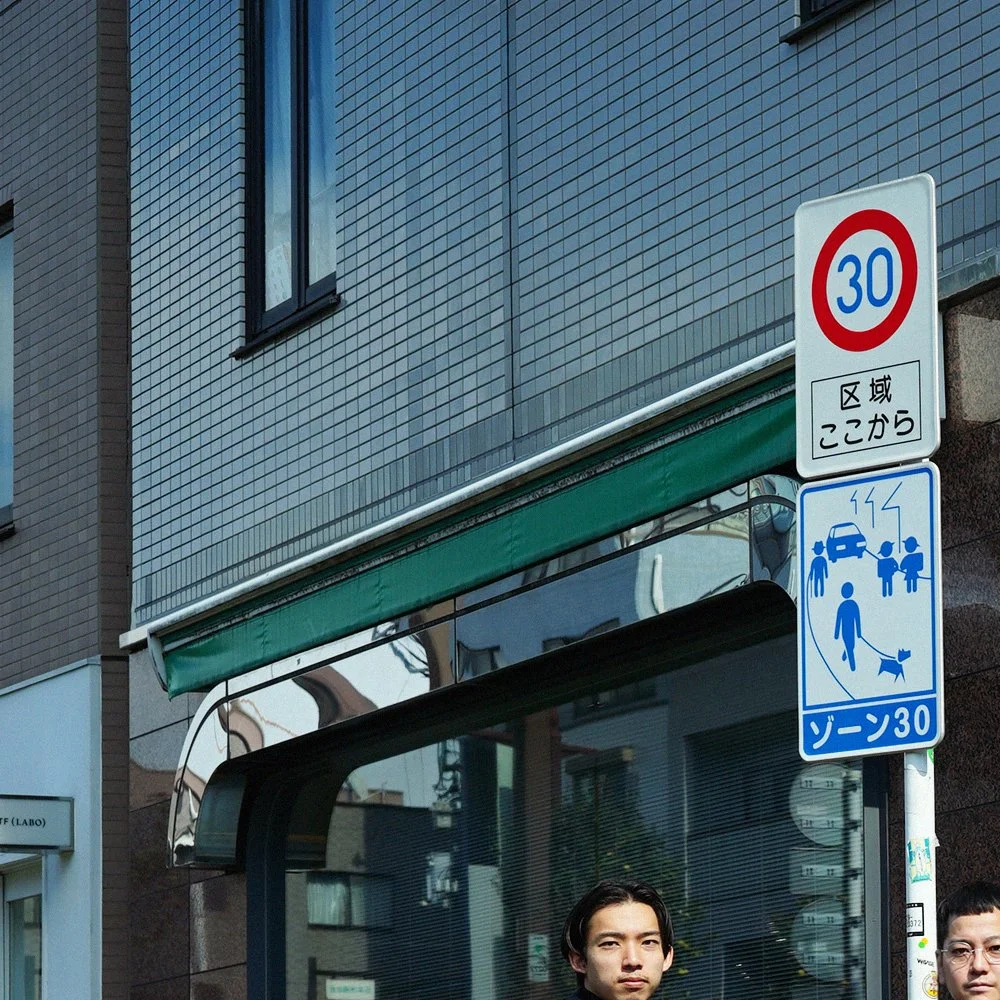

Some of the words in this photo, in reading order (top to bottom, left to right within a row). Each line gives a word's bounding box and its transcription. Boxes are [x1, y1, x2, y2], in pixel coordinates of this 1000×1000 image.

[836, 247, 894, 314] 30
[840, 374, 893, 411] 区域
[819, 410, 915, 450] ここから
[810, 704, 931, 750] ゾーン30
[11, 817, 46, 828] (LABO)
